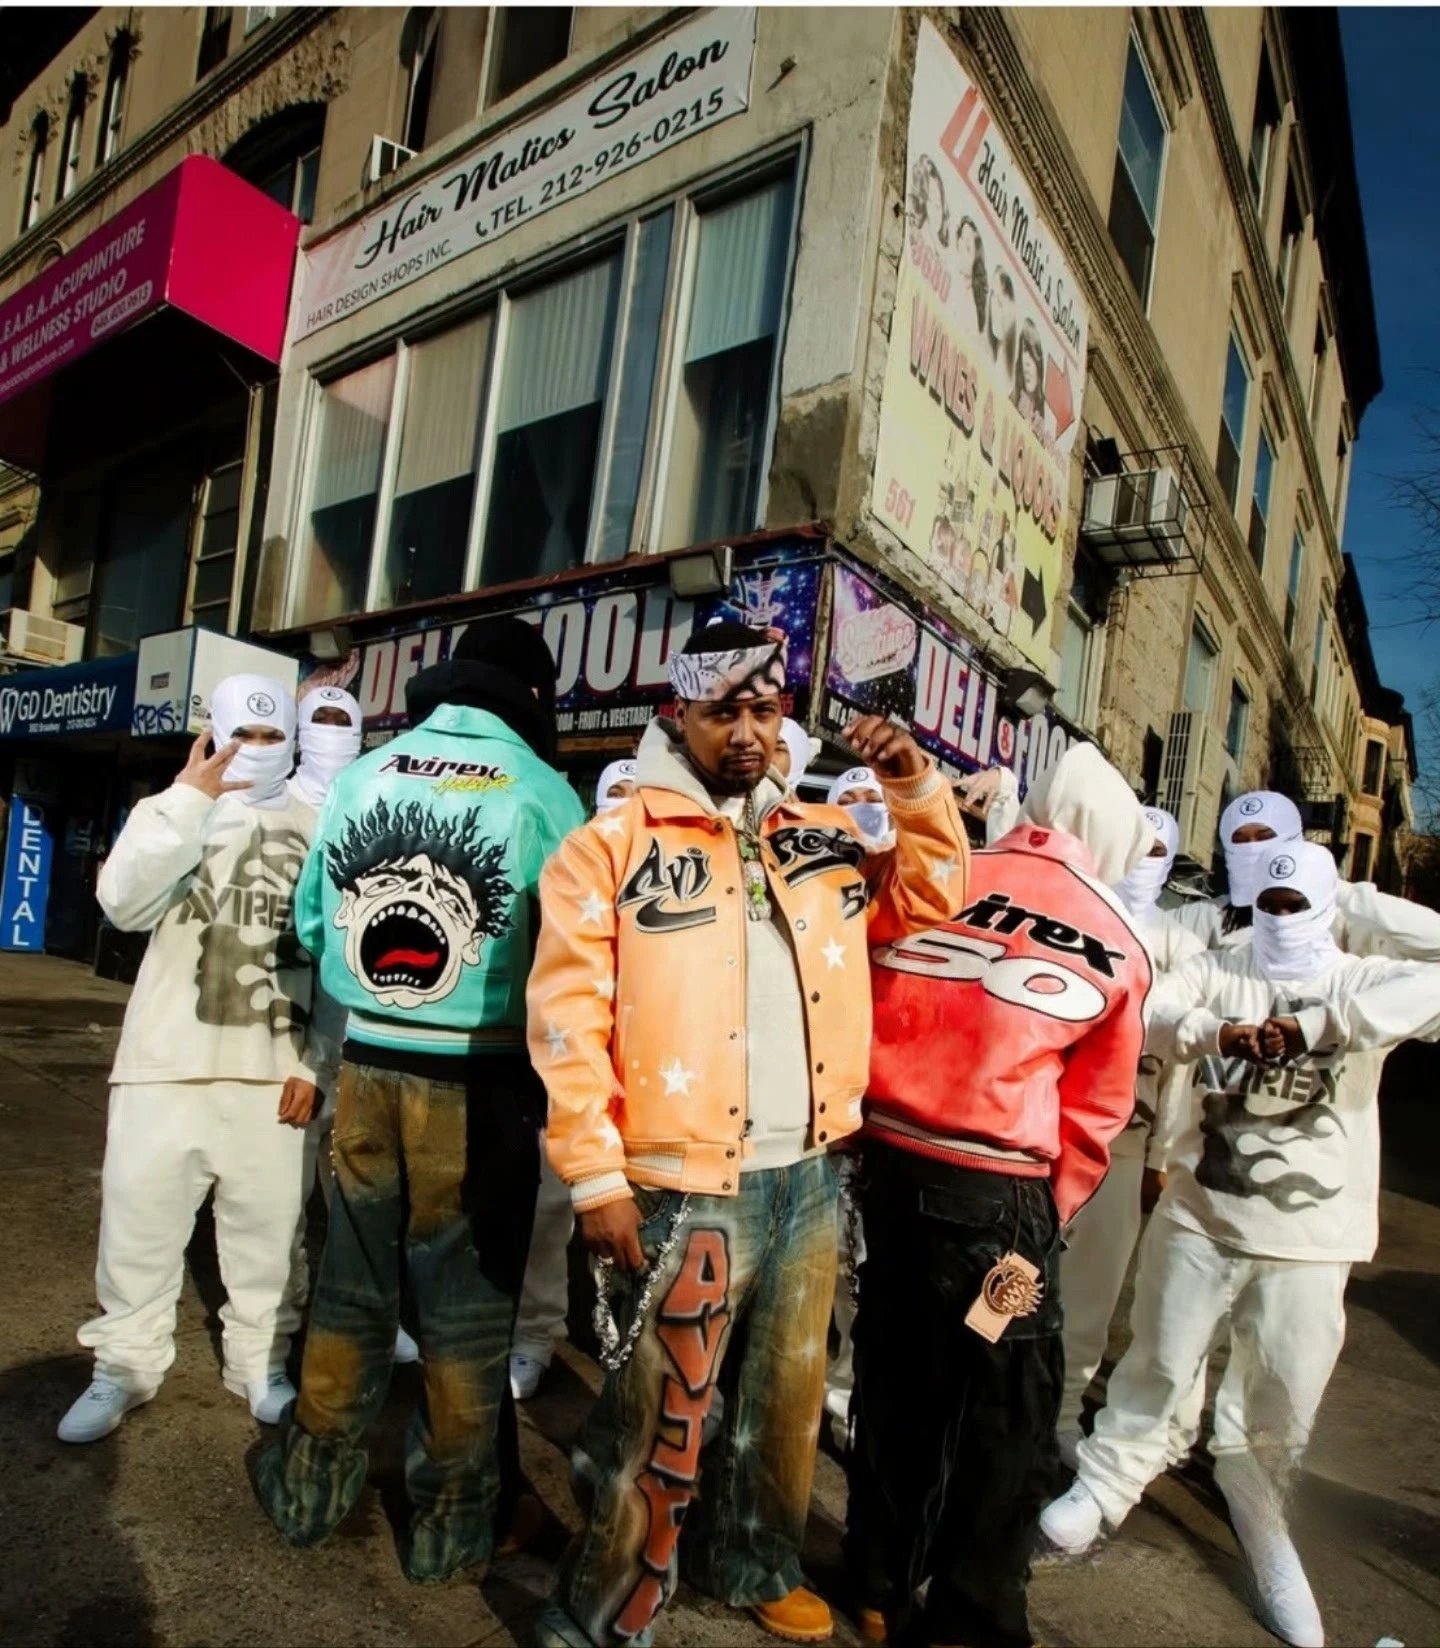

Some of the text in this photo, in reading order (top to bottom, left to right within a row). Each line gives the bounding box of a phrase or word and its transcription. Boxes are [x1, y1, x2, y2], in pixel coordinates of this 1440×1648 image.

[354, 39, 729, 270] Hair Matics Salon
[490, 86, 724, 231] TEL. 212-926-0215
[305, 239, 454, 328] HAIR DESIGN SHOPS INC.
[978, 140, 1008, 229] Hair
[1053, 278, 1081, 351] Salon
[11, 308, 71, 365] WELLNESS
[73, 268, 126, 323] STUDIO
[910, 294, 977, 438] WINES
[514, 588, 697, 698] OOD
[17, 691, 40, 721] GD
[42, 683, 117, 721] Dentistry
[578, 710, 602, 730] FRUIT
[609, 705, 654, 727] VEGETABLE
[914, 628, 997, 766] DELI
[379, 754, 502, 780] Avirex
[871, 927, 1108, 1023] 50
